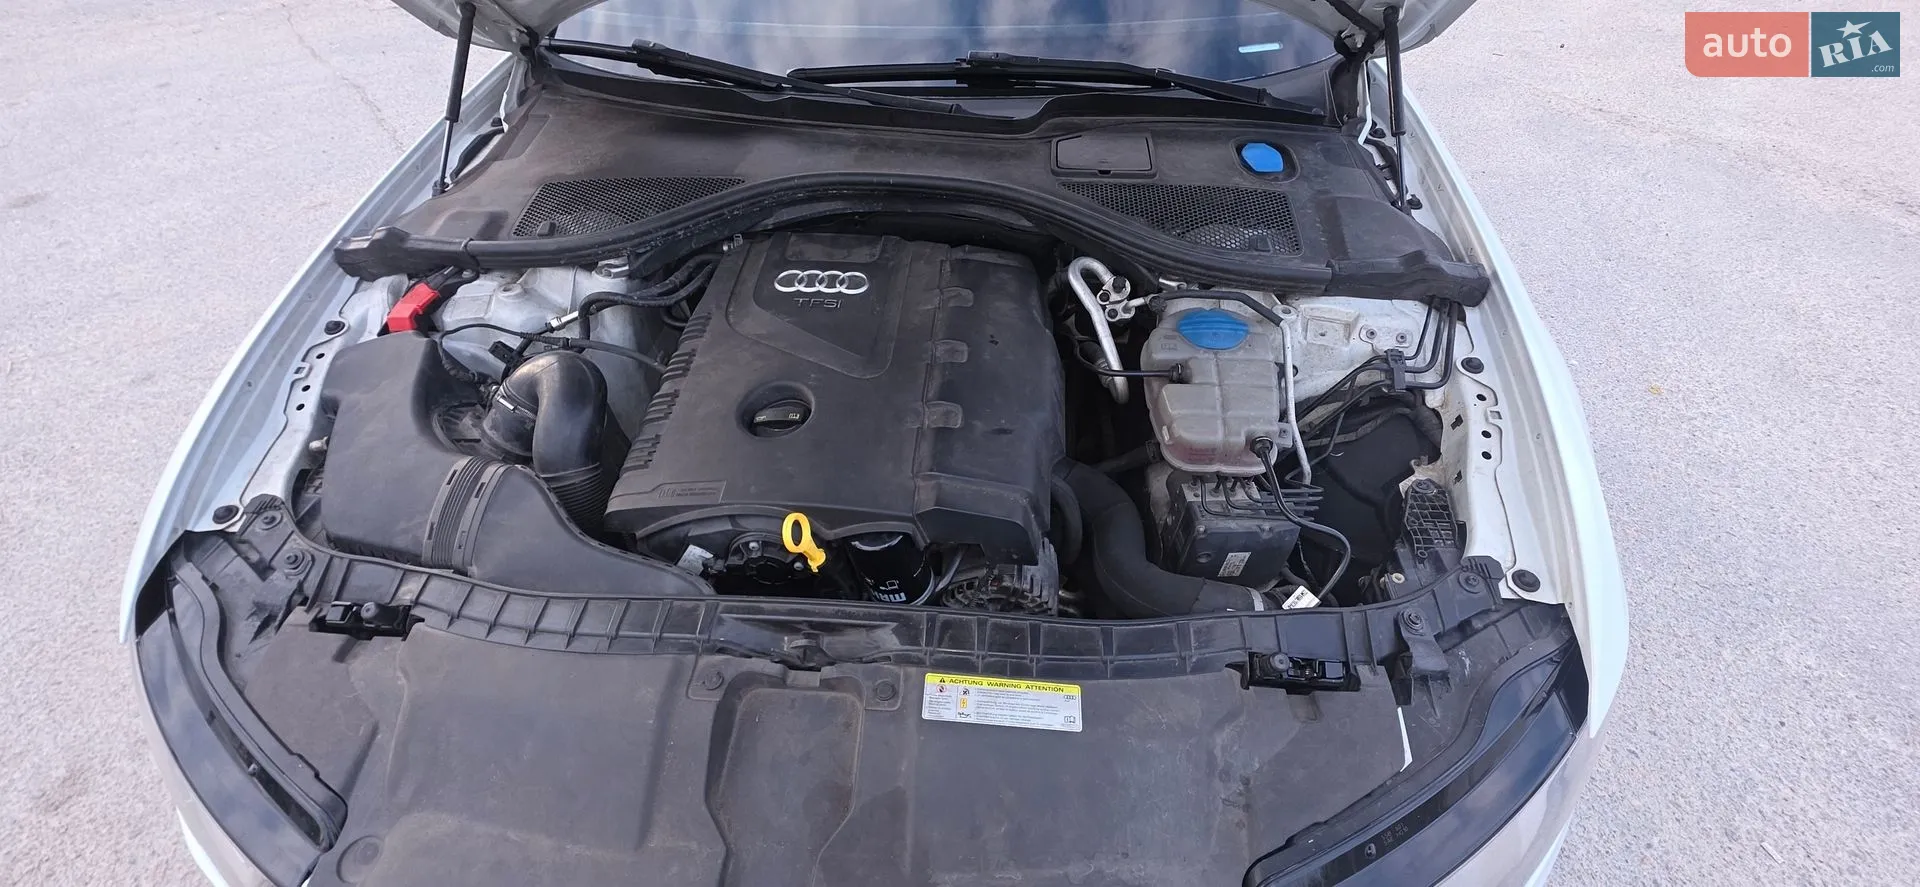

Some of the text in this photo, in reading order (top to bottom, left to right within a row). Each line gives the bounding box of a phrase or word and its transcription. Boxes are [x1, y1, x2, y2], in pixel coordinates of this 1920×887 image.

[794, 298, 842, 309] TFSI
[949, 678, 1064, 693] ACHTUNG WARNING ATTENTION
